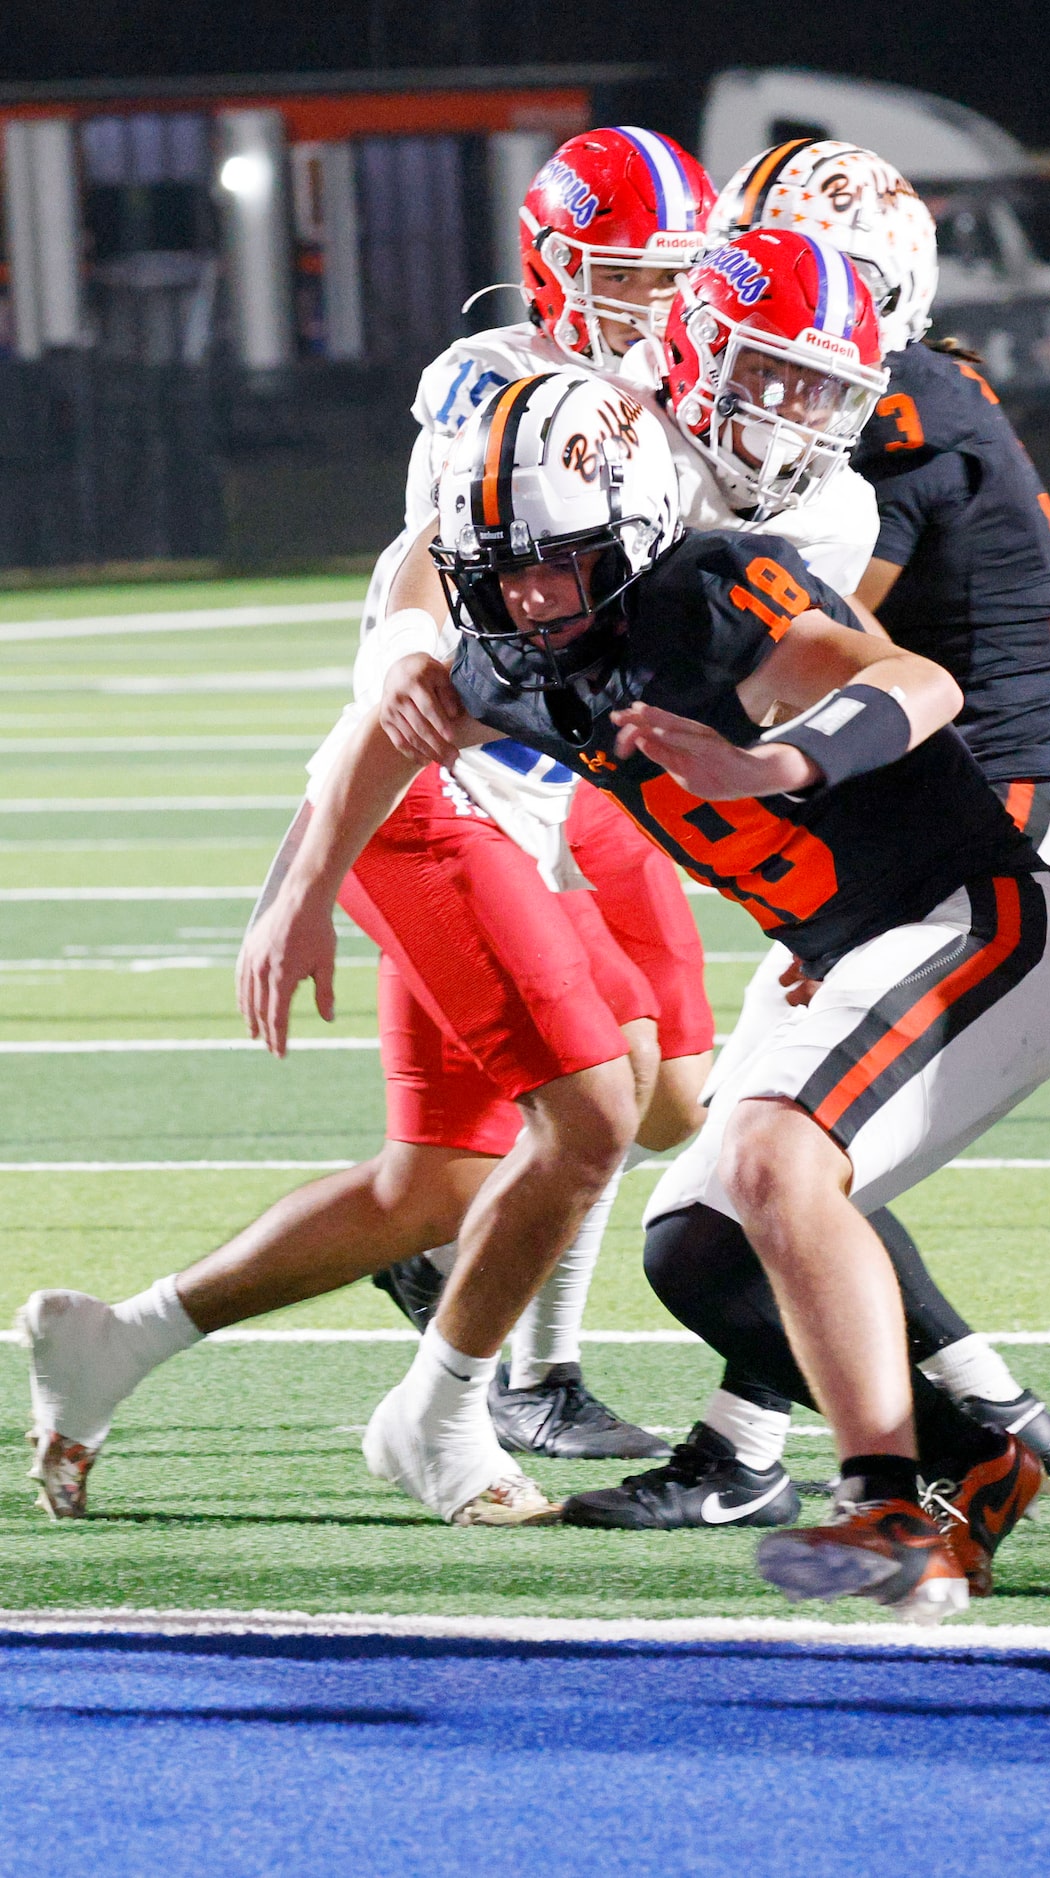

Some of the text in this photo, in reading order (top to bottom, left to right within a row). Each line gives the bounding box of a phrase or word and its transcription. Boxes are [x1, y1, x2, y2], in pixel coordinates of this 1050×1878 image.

[531, 148, 599, 229] exans
[702, 246, 769, 305] exans
[805, 332, 855, 360] Riddell
[875, 393, 925, 452] 3
[729, 556, 811, 642] 18
